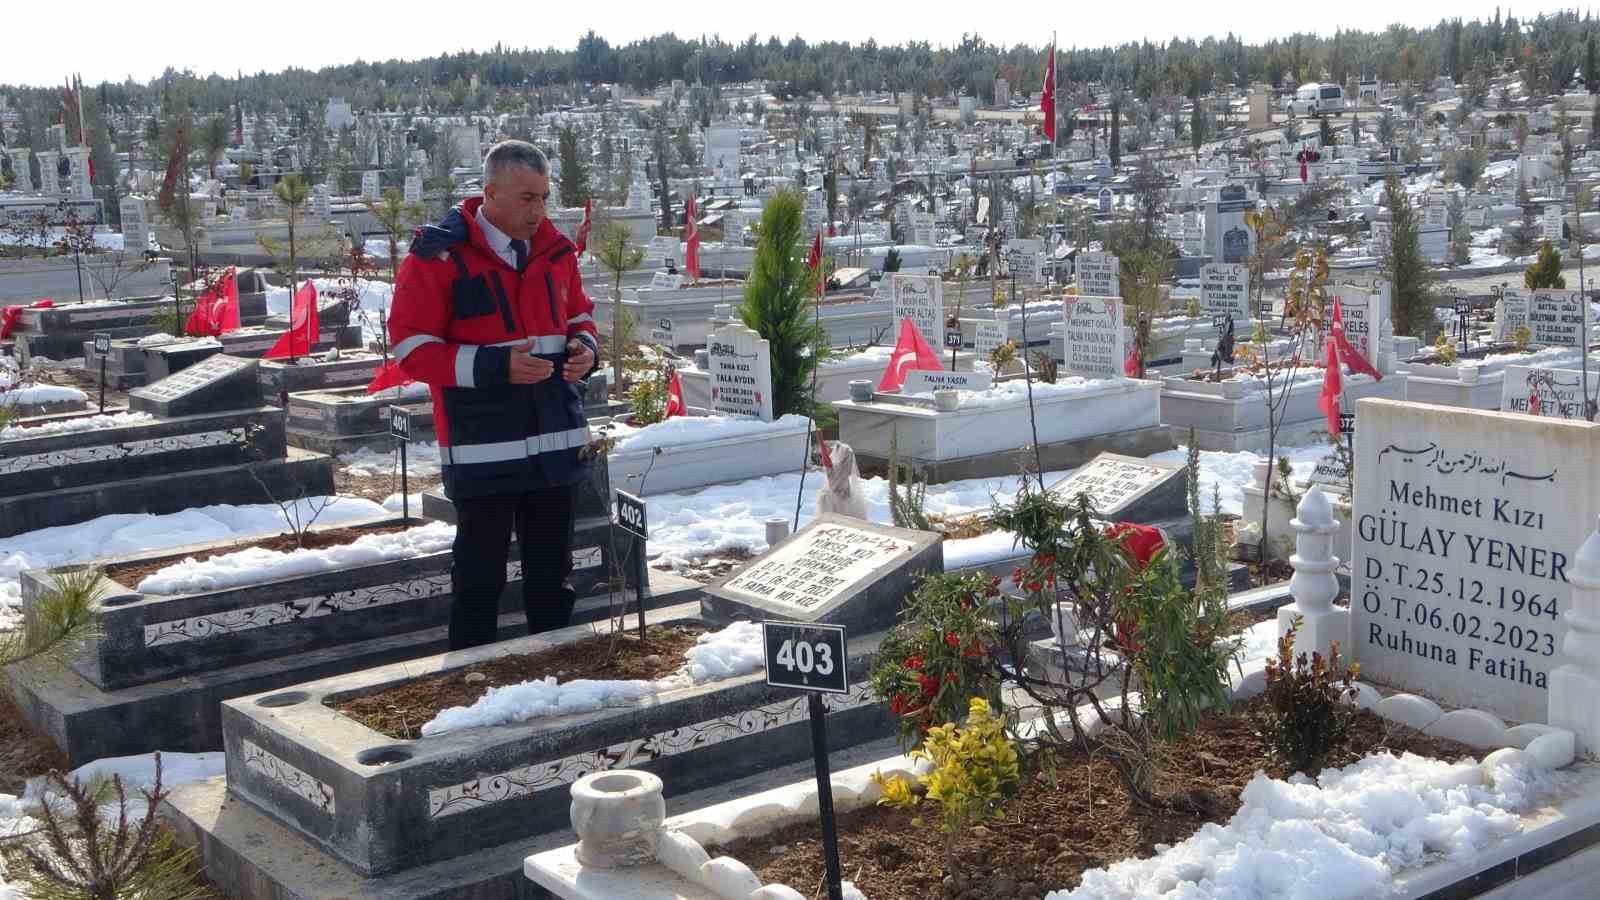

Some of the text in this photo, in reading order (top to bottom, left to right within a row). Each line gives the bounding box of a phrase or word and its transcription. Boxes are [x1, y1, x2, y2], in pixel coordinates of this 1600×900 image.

[393, 414, 408, 433] 401
[620, 502, 643, 529] 402
[1389, 479, 1482, 518] Mehmet
[1358, 508, 1570, 583] GÜLAY YENER
[776, 639, 834, 676] 403
[1369, 622, 1549, 689] Ruhuna Fatiha
